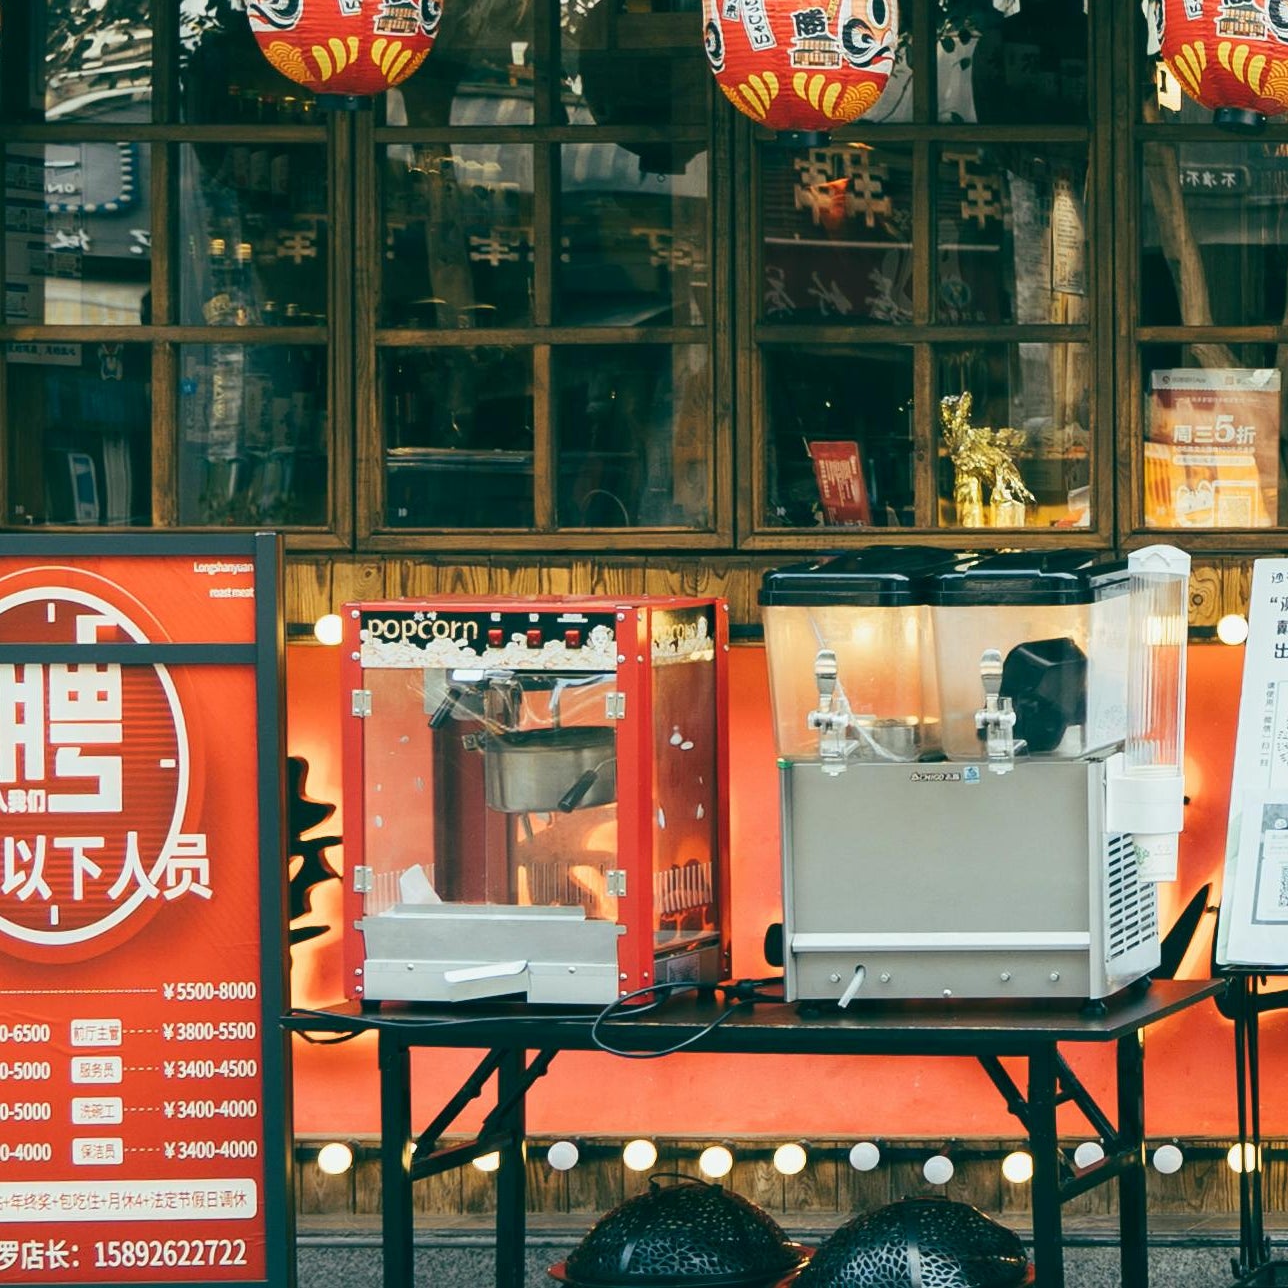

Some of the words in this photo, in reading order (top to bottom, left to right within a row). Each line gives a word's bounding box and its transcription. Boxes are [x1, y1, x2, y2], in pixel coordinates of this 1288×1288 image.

[1173, 414, 1257, 445] 周三5折
[367, 618, 479, 646] popcorn
[0, 831, 214, 901] 以下人员
[93, 1238, 248, 1268] 15892622722
